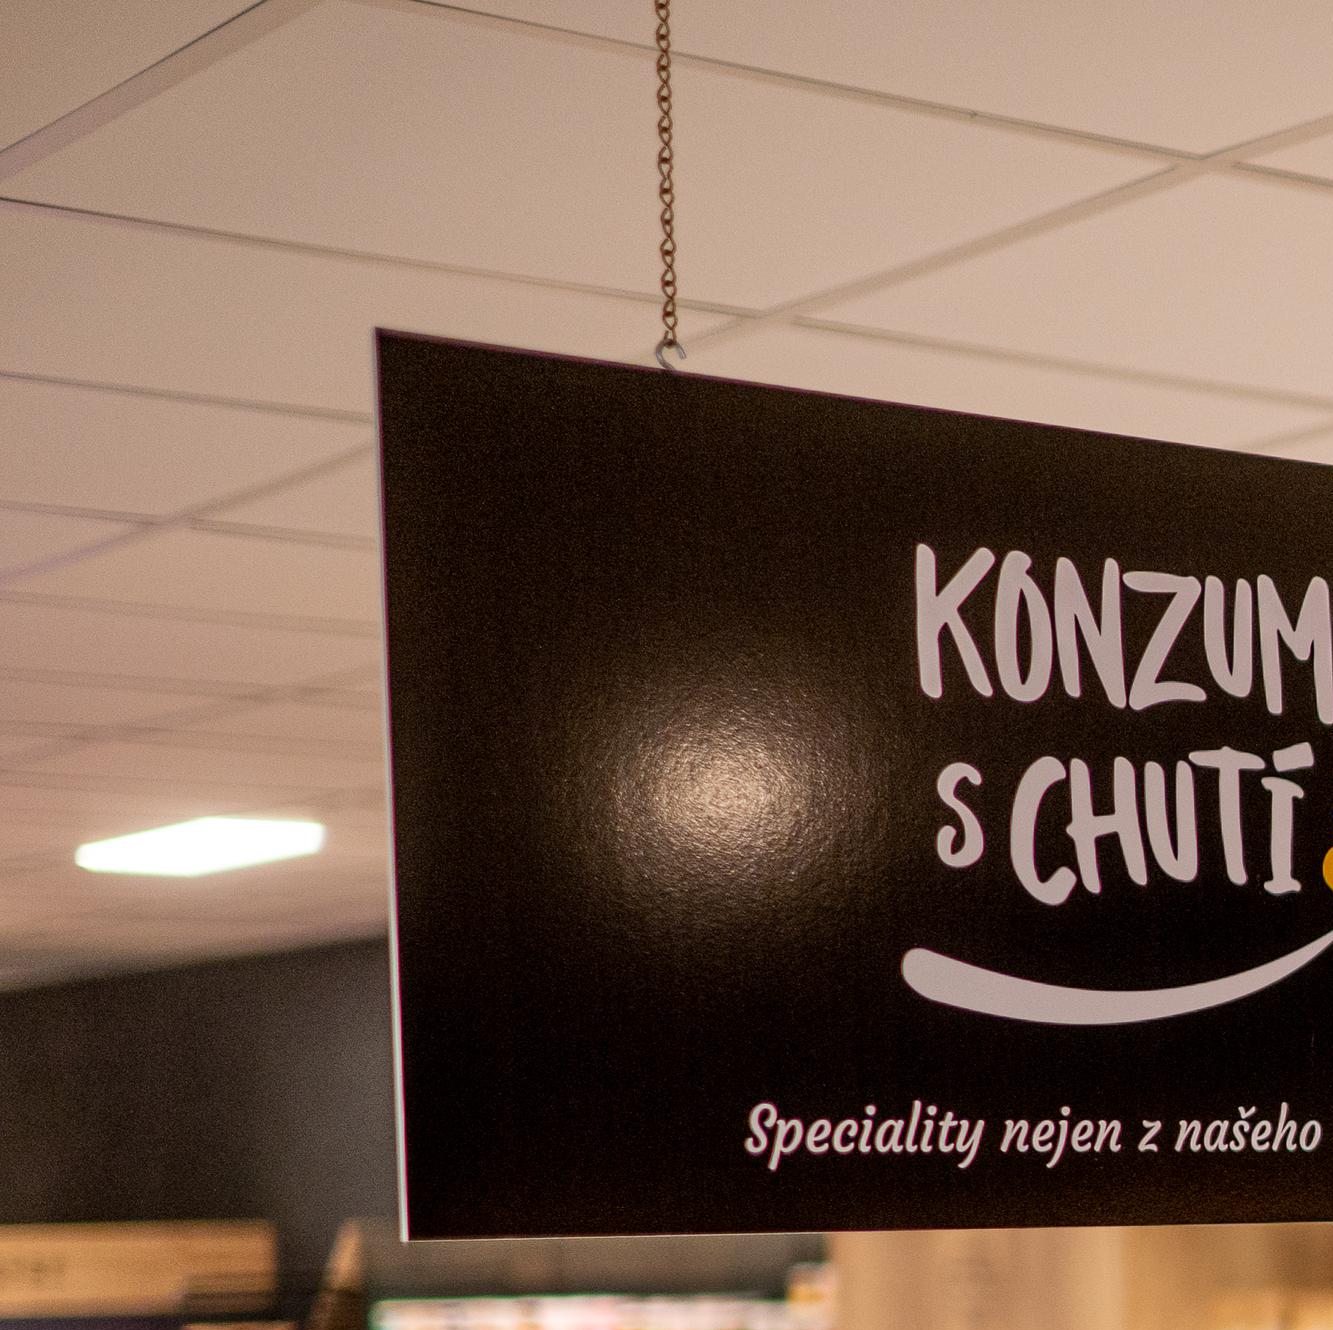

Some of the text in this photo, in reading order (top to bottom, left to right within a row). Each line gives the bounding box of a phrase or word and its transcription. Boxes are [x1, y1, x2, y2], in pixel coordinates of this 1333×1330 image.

[1010, 741, 1315, 906] CHUTÍ
[745, 1100, 985, 1171] Speciality
[1000, 1106, 1122, 1169] nejen
[1138, 1119, 1162, 1152] z
[1174, 1102, 1322, 1152] našeho
